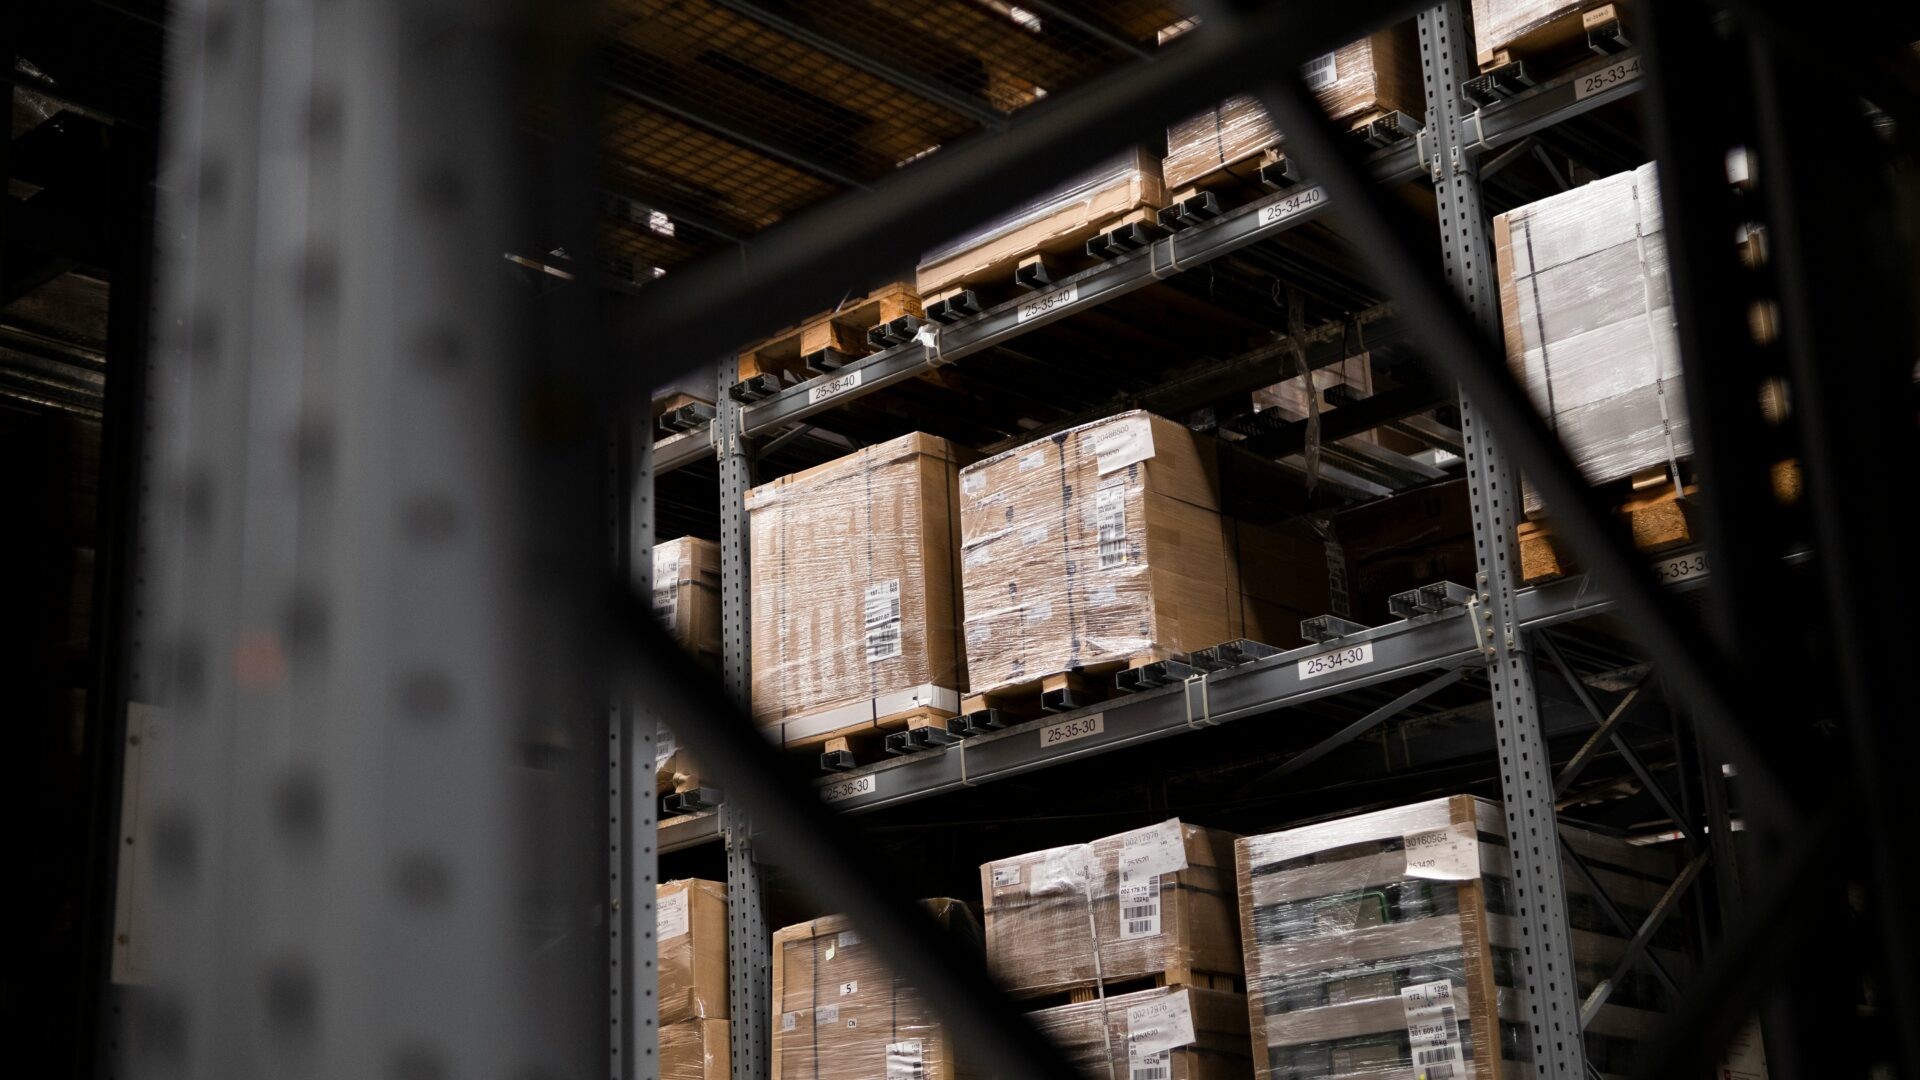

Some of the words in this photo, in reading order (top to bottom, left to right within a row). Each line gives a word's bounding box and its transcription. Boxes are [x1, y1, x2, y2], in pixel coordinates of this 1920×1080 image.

[1267, 189, 1320, 221] 25-34-40
[1025, 289, 1070, 317] 25-35-40
[815, 374, 855, 399] 25-36-40
[1308, 647, 1363, 674] 25-34-30
[1048, 718, 1096, 743] 25-35-30
[826, 778, 869, 800] 25-36-30
[1405, 833, 1448, 848] 30160964
[846, 984, 852, 994] 5
[1409, 993, 1420, 1001] 172
[1133, 1003, 1168, 1019] 00217976
